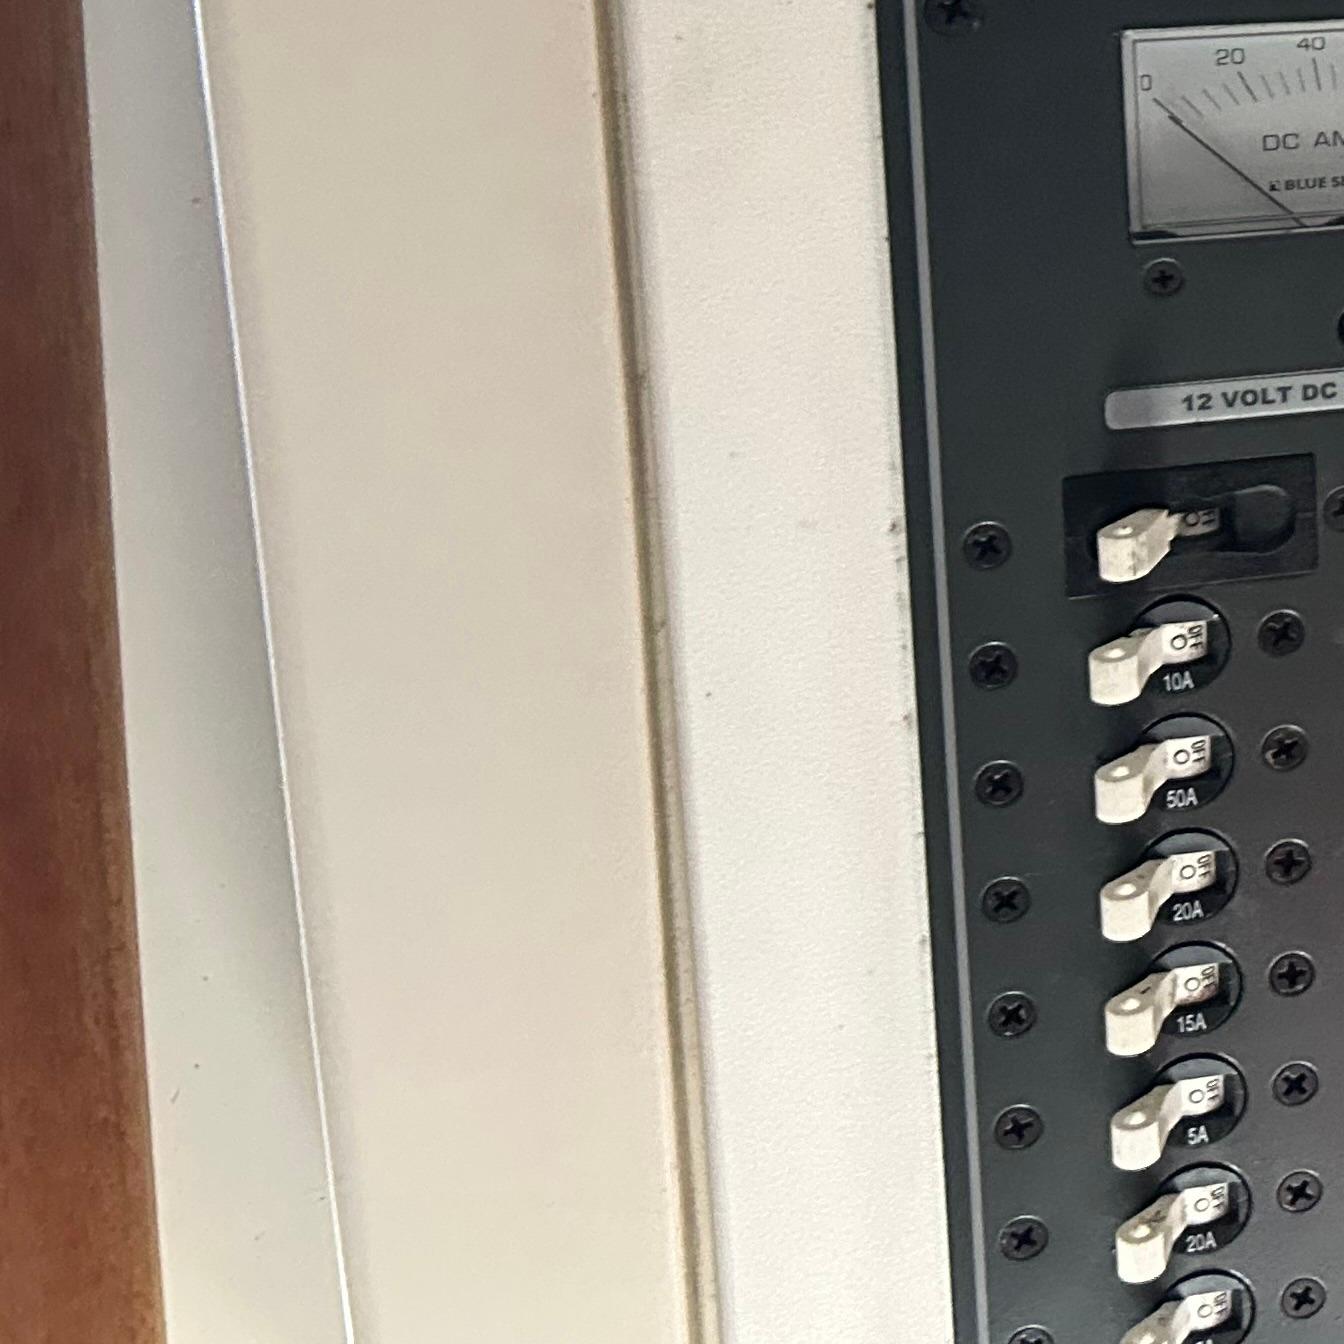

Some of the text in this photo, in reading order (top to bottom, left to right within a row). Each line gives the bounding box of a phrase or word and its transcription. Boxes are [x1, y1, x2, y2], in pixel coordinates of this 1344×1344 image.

[1215, 48, 1245, 65] 20
[1296, 35, 1325, 51] 40
[1262, 132, 1300, 152] DC
[1284, 177, 1327, 192] BLUE
[1182, 394, 1213, 412] 12
[1221, 385, 1293, 410] VOLT
[1302, 381, 1338, 402] DC
[1163, 672, 1194, 692] 10A
[1166, 788, 1198, 808] 50A
[1173, 901, 1204, 922] 20A
[1177, 1012, 1207, 1033] 15A
[1187, 1125, 1209, 1146] 5A
[1186, 1231, 1217, 1253] 20A
